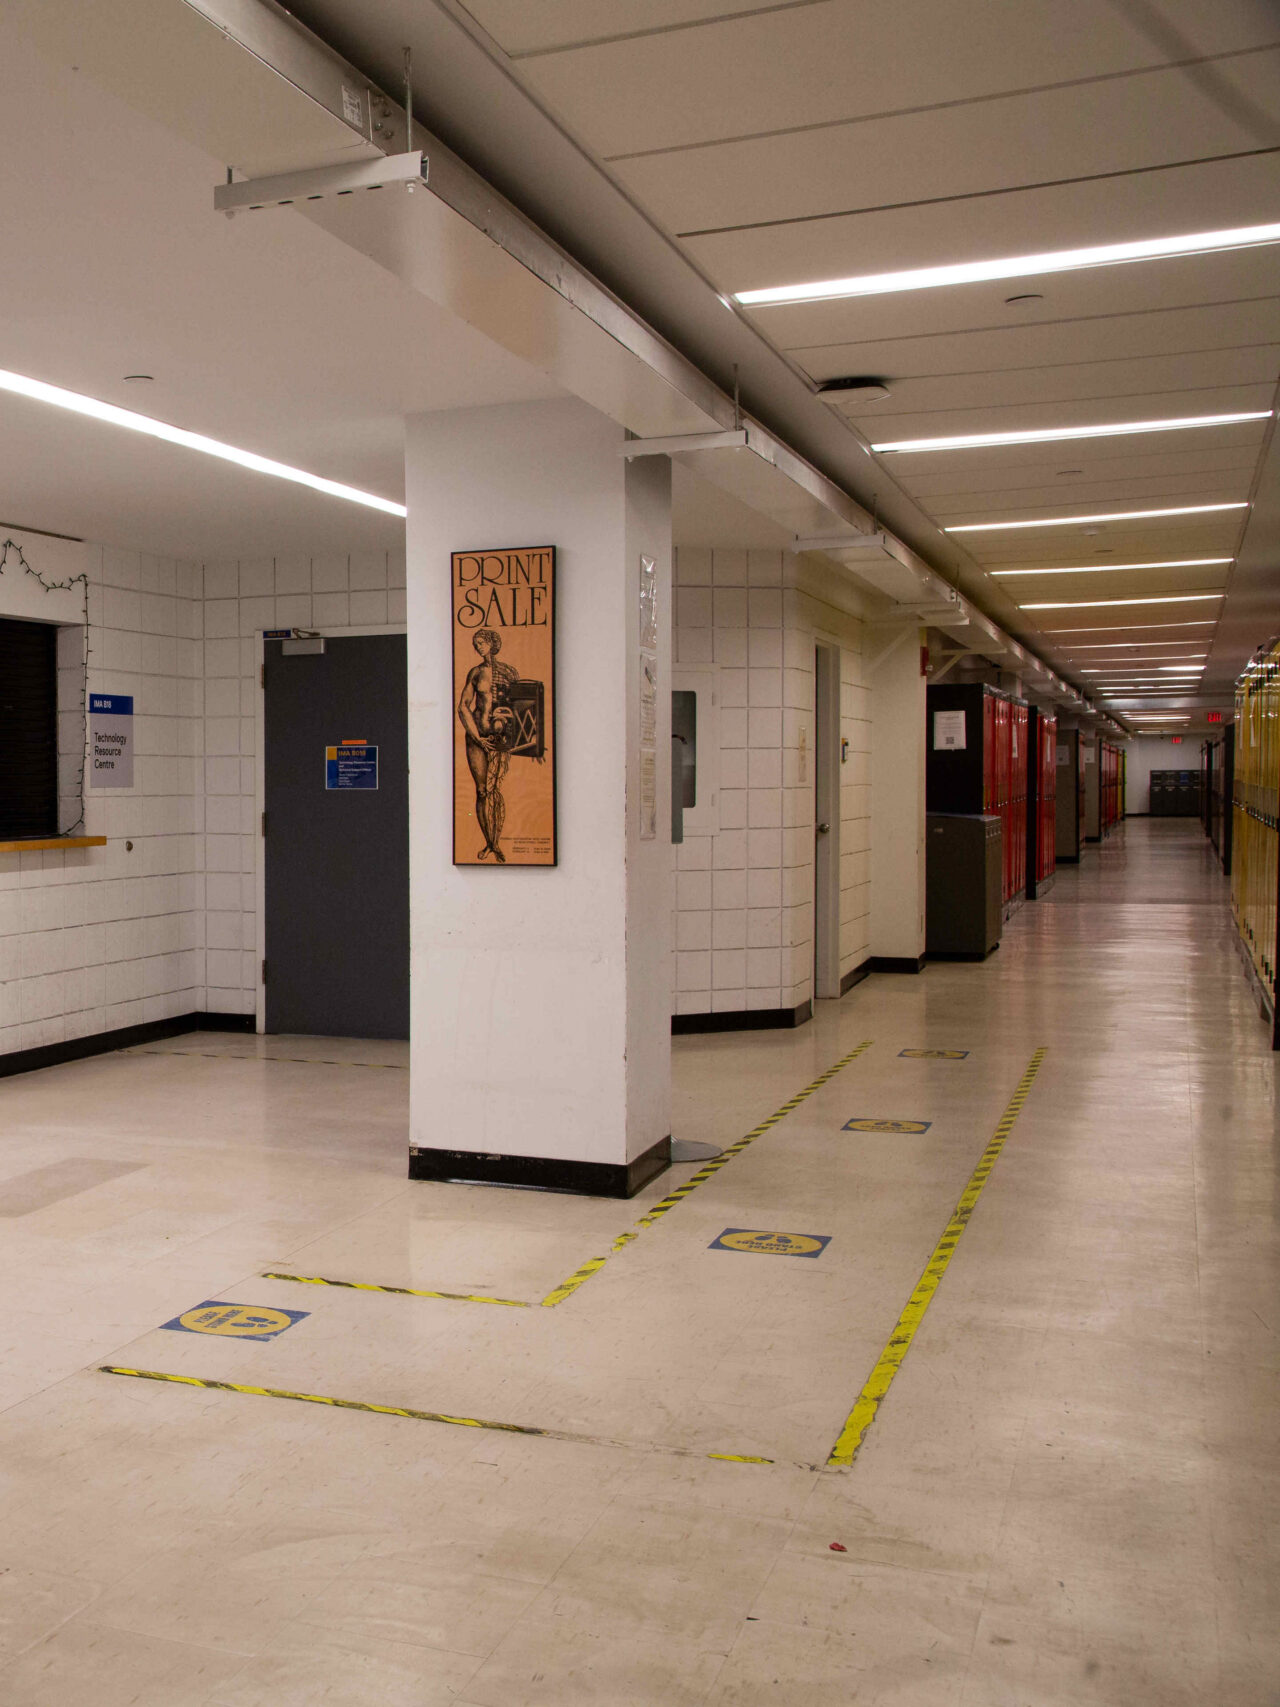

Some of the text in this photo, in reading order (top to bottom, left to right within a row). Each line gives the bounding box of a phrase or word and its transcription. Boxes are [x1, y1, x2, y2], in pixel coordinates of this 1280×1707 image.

[457, 552, 550, 587] PRINT
[457, 585, 548, 628] SALE
[94, 700, 103, 708] IMA
[94, 732, 127, 745] Technology
[94, 746, 122, 756] Resource
[94, 759, 115, 769] Centre
